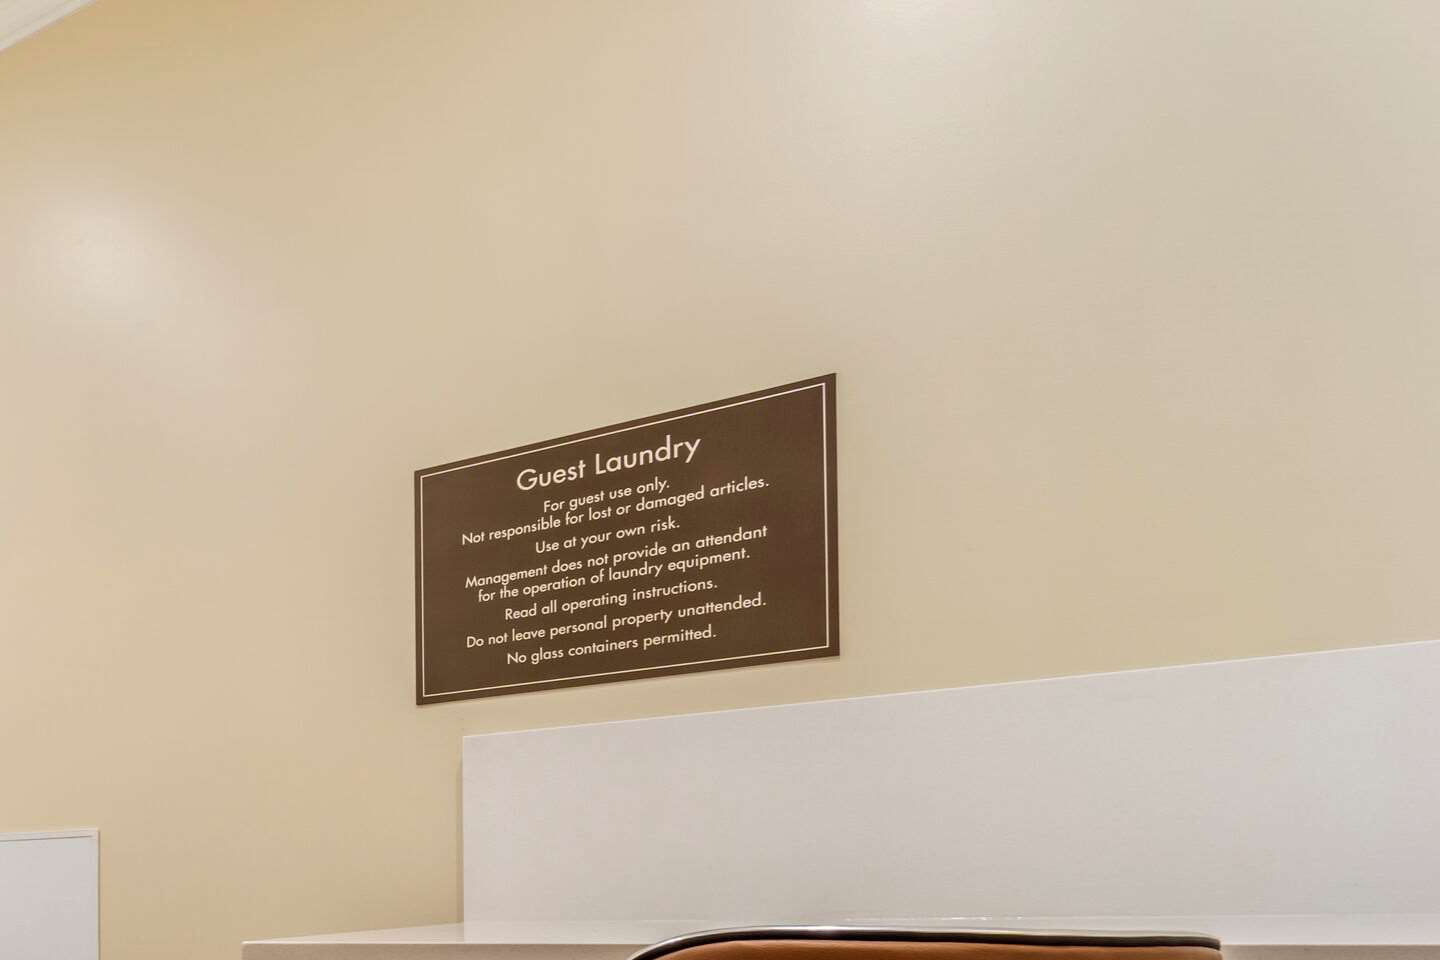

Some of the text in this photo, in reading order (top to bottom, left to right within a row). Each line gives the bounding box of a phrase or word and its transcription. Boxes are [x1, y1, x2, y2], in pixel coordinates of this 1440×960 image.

[516, 434, 702, 491] Guest Laundry
[461, 475, 770, 546] Not responsible for lost or damaged articles.
[543, 475, 670, 513] For guest use only.
[464, 525, 768, 590] Management does not provide an attendant
[535, 514, 680, 554] Use at your own risk.
[478, 547, 750, 603] for the operation of laundry equipment.
[505, 580, 718, 621] Read all operating instructions.
[466, 591, 767, 649] Do not leave personal property unattended.
[507, 623, 717, 665] No glass containers permitted.
